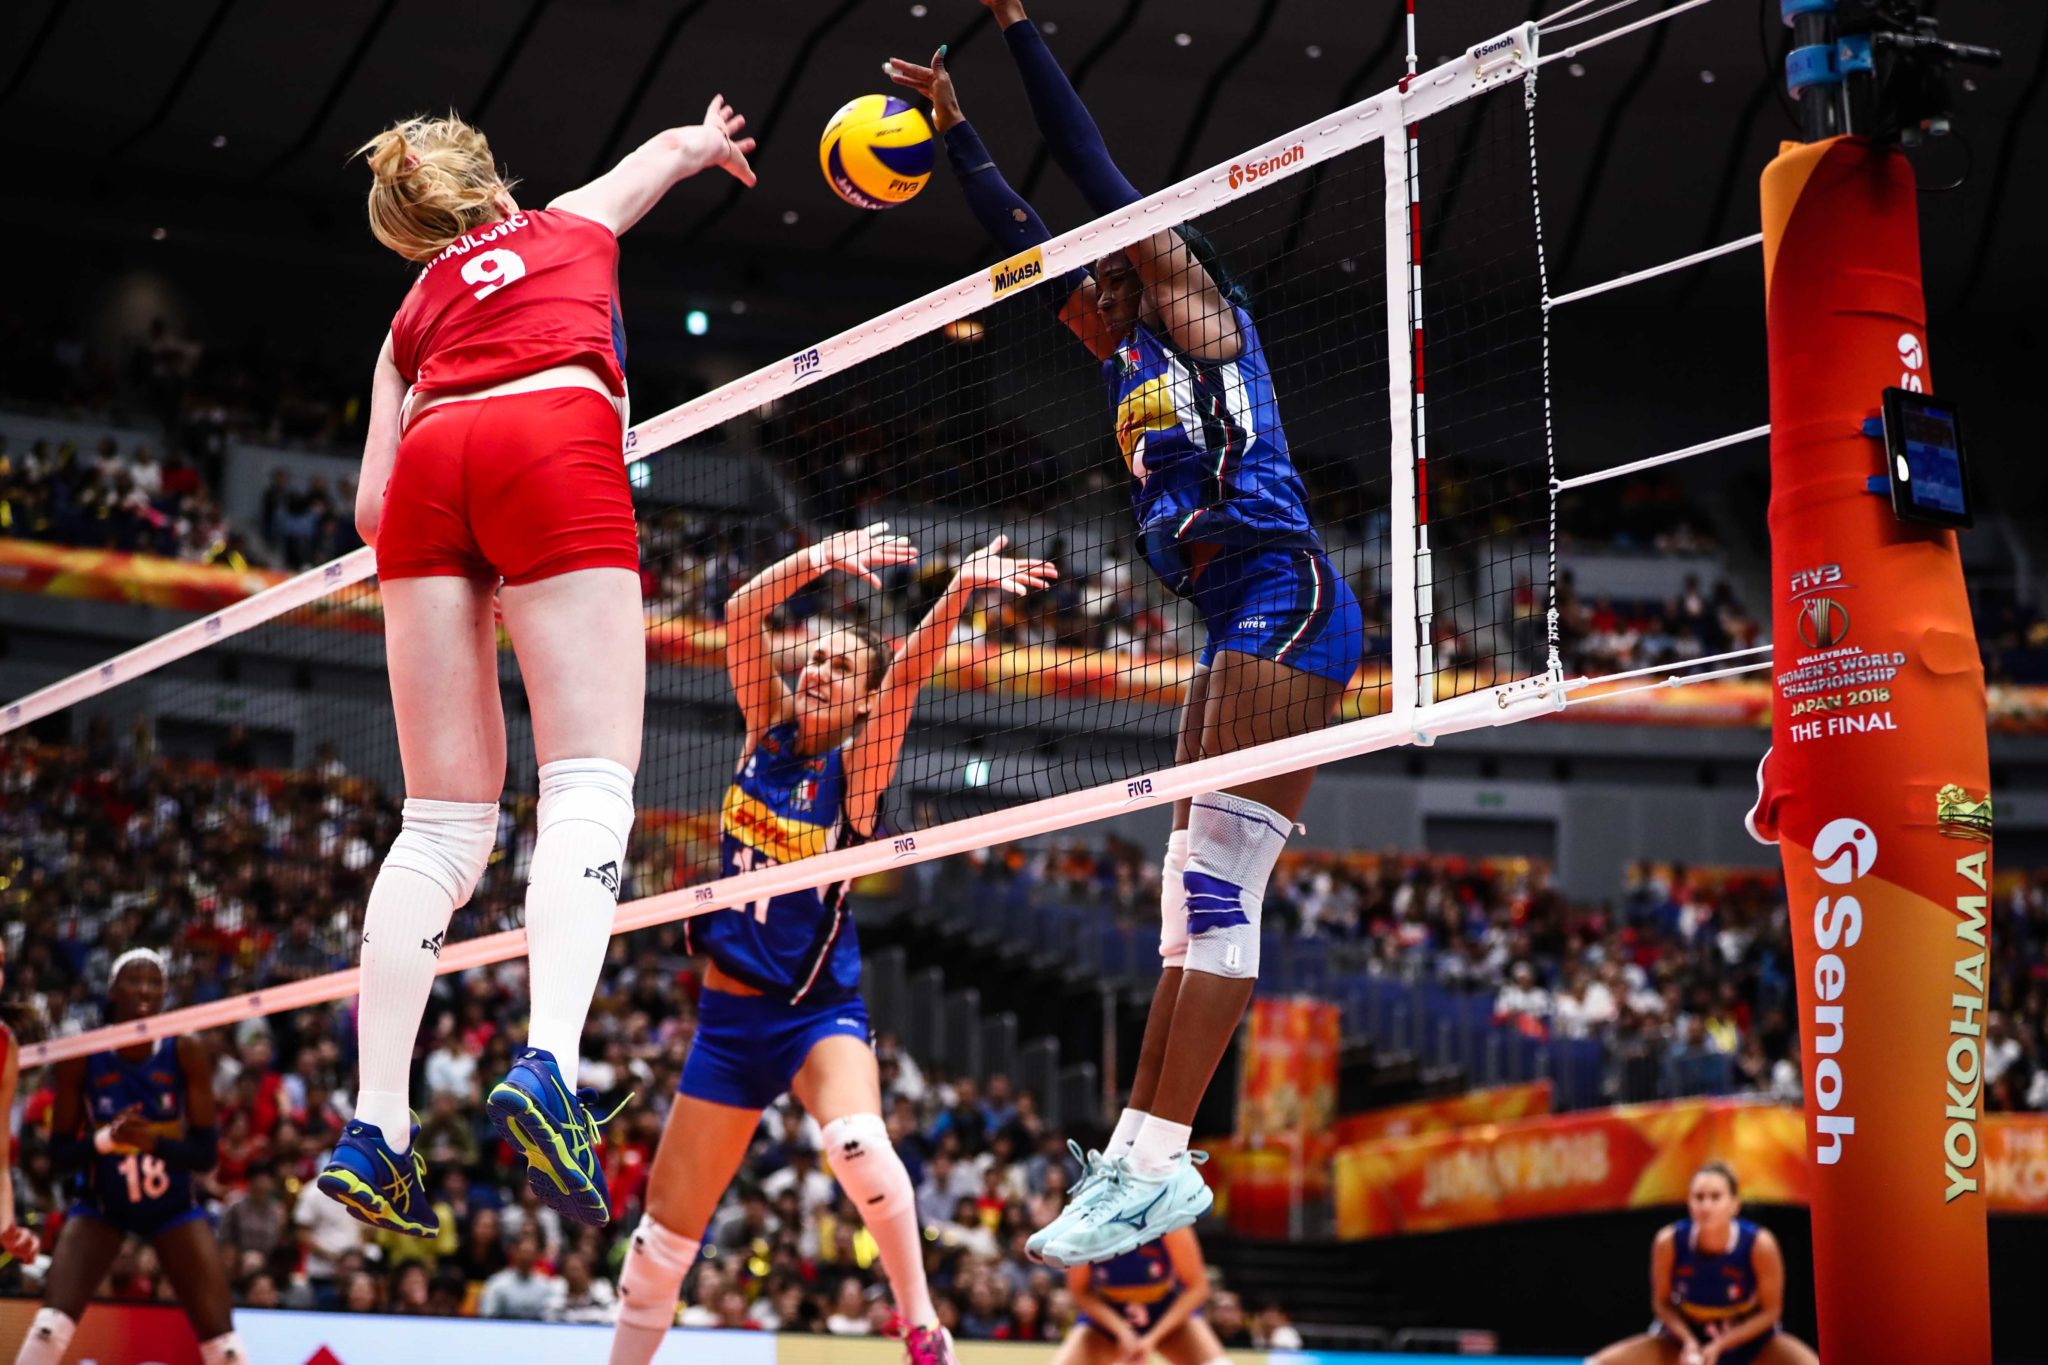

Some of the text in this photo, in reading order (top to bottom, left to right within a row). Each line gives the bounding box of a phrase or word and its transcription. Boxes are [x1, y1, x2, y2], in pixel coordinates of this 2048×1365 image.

[1482, 36, 1514, 55] Senoh
[1245, 145, 1304, 182] Senoh
[461, 248, 526, 301] 9
[793, 349, 819, 375] FIVB
[1791, 563, 1842, 592] FIVB
[1777, 652, 1906, 687] WOMEN'S WORLD
[1796, 646, 1863, 666] VOLLEYBALL
[1782, 668, 1897, 698] CHAMPIONSHIP
[1790, 687, 1891, 717] JAPAN 2018
[1790, 711, 1898, 743] THE FINAL
[1127, 778, 1153, 798] FIVB
[894, 837, 916, 854] FIVB
[1813, 895, 1863, 1165] Senoh
[1943, 850, 1989, 1203] YOKOHAMA
[117, 1153, 170, 1204] 18
